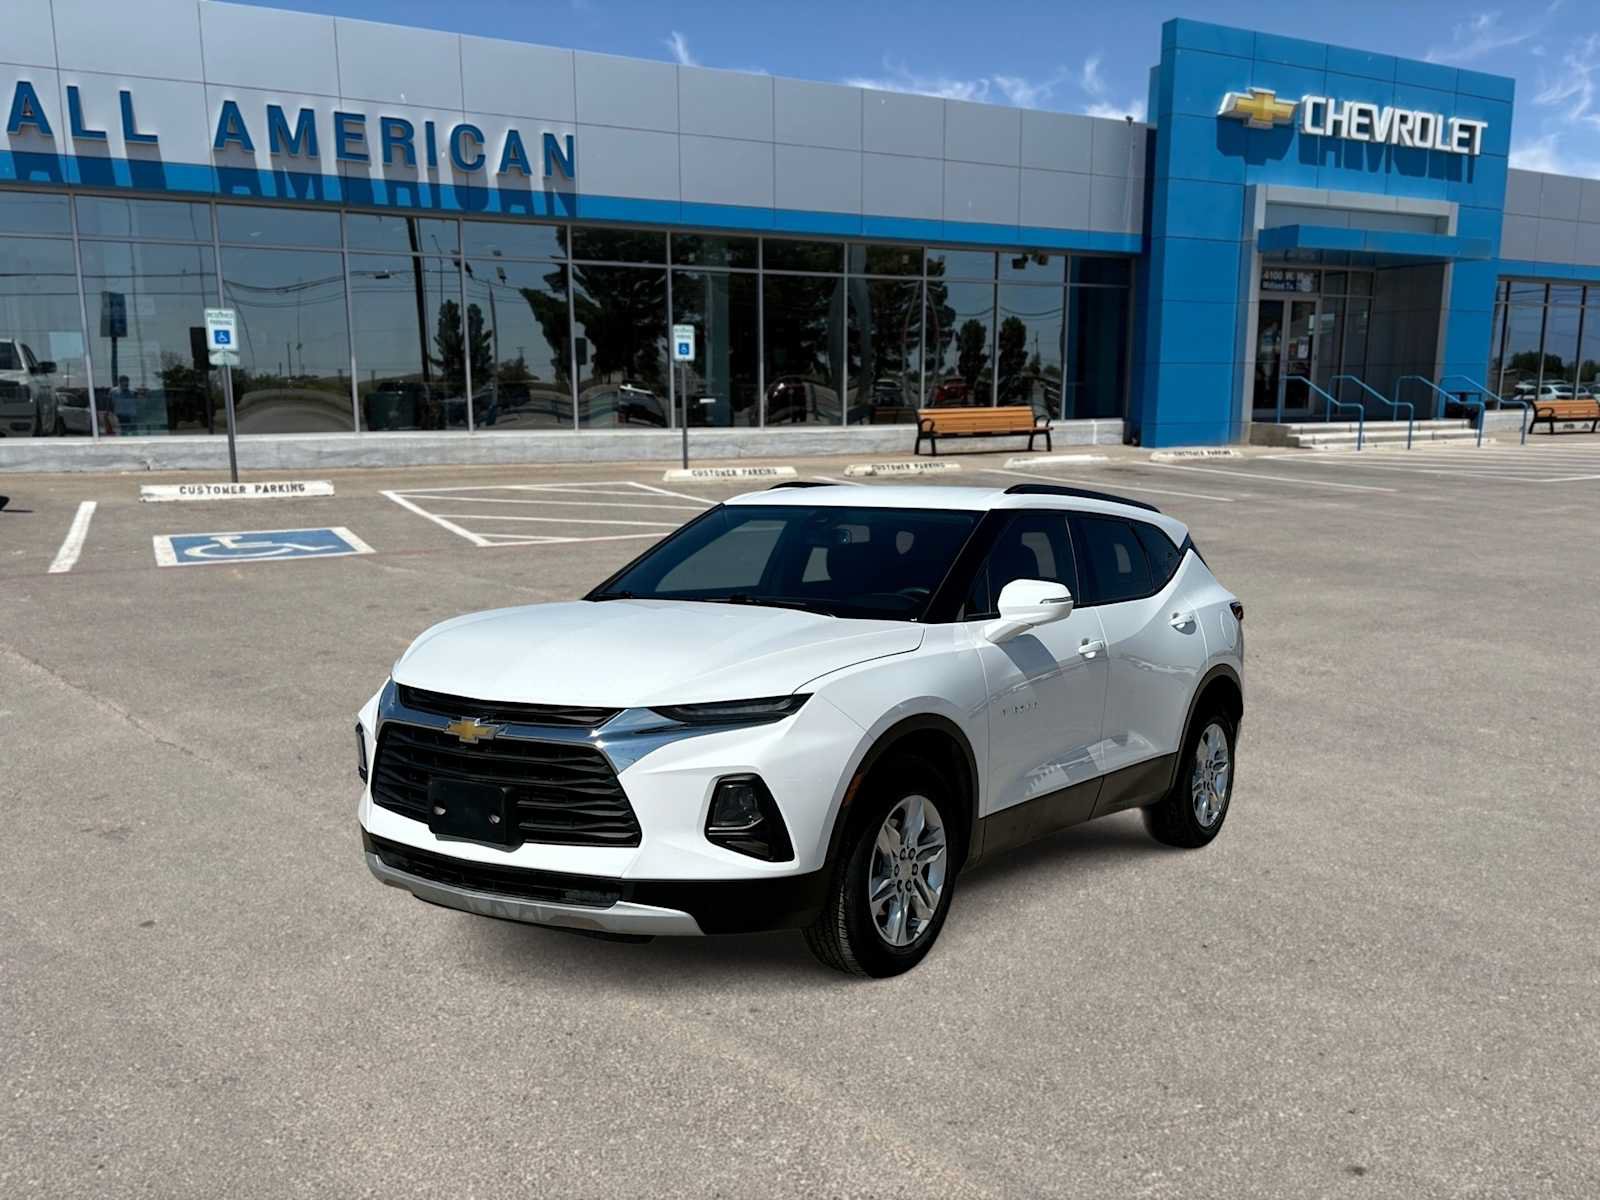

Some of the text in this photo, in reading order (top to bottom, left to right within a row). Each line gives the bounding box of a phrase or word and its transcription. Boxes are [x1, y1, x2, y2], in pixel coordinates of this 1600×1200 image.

[7, 81, 575, 179] ALL AMERICAN
[1302, 94, 1488, 155] CHEVROLET
[179, 483, 306, 495] CUSTOMER PARKING
[691, 469, 737, 477] CUSTOMER
